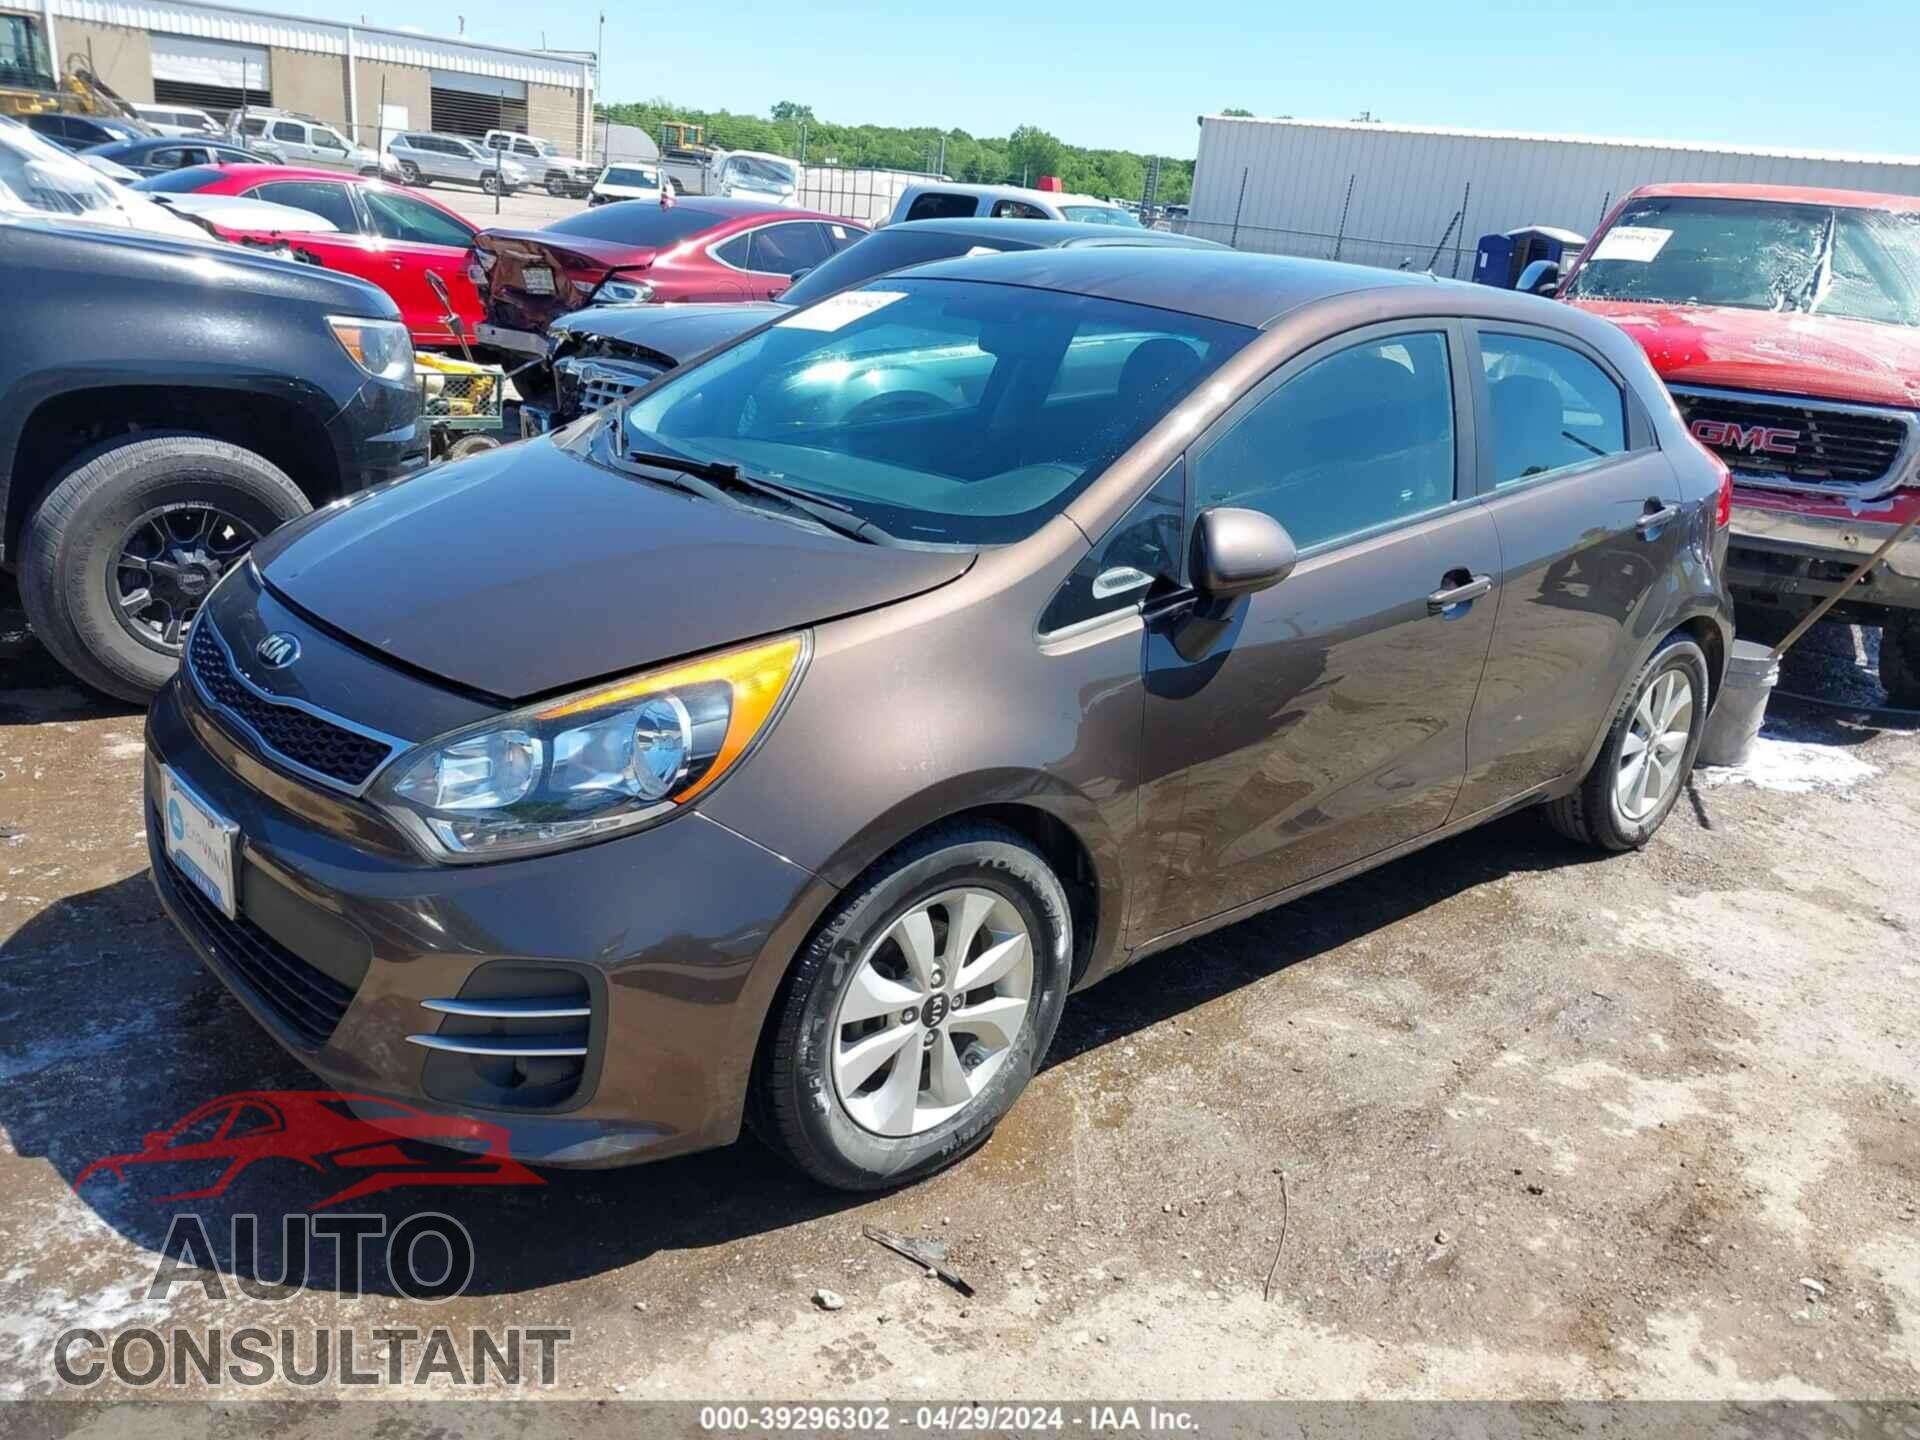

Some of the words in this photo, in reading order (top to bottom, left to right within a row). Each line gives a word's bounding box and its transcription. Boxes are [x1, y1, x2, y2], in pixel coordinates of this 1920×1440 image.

[1690, 419, 1801, 455] GMC
[261, 634, 292, 665] KIA
[929, 996, 943, 1025] KIA
